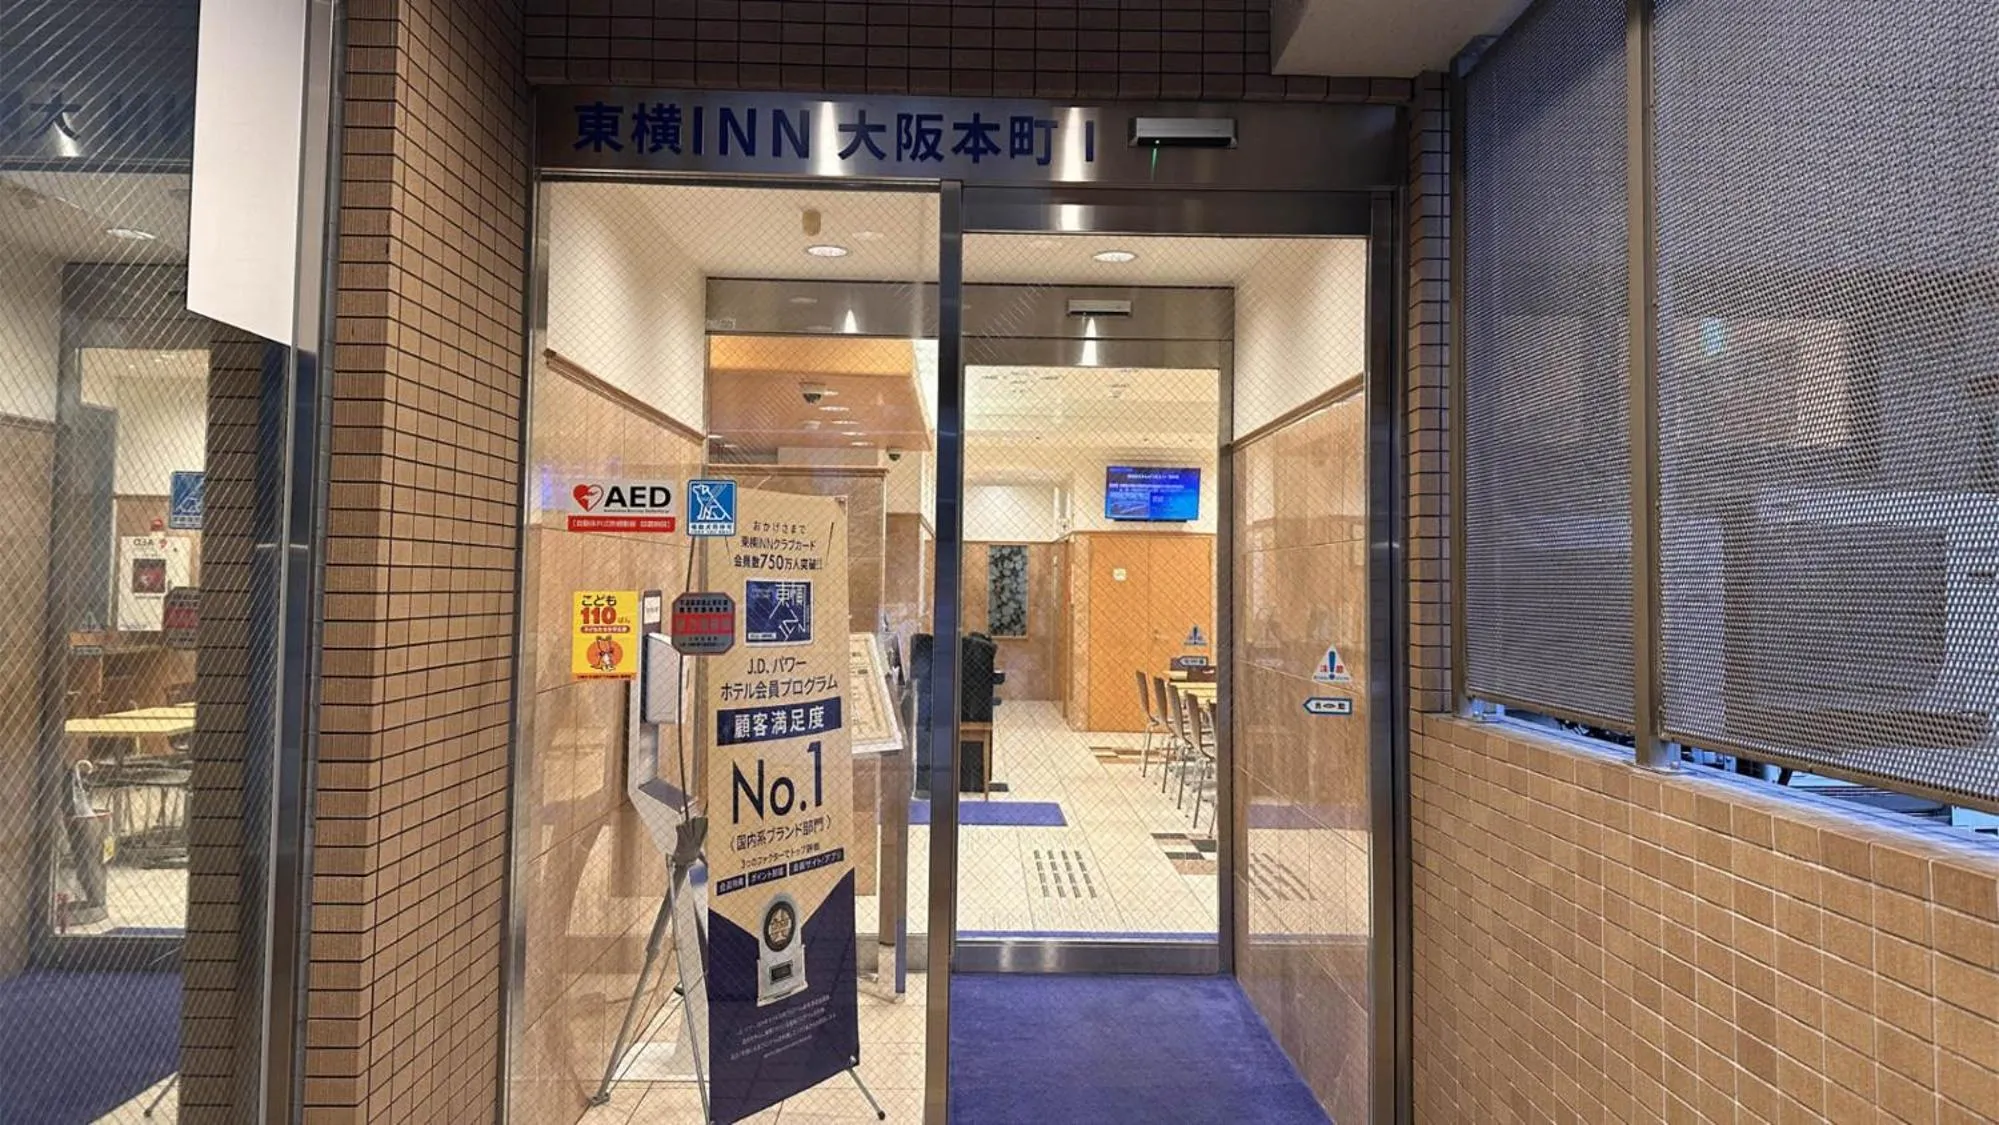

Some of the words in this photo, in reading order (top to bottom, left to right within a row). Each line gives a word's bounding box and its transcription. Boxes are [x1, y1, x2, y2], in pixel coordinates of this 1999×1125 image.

[573, 101, 811, 159] 東横INN
[838, 109, 1058, 165] 大阪本町
[604, 486, 671, 508] AED
[753, 521, 807, 534] おかげさまで
[581, 594, 617, 606] こども
[720, 674, 839, 701] ホテル会員プログラム
[733, 705, 826, 739] 顧客満足度
[732, 740, 824, 825] No.1
